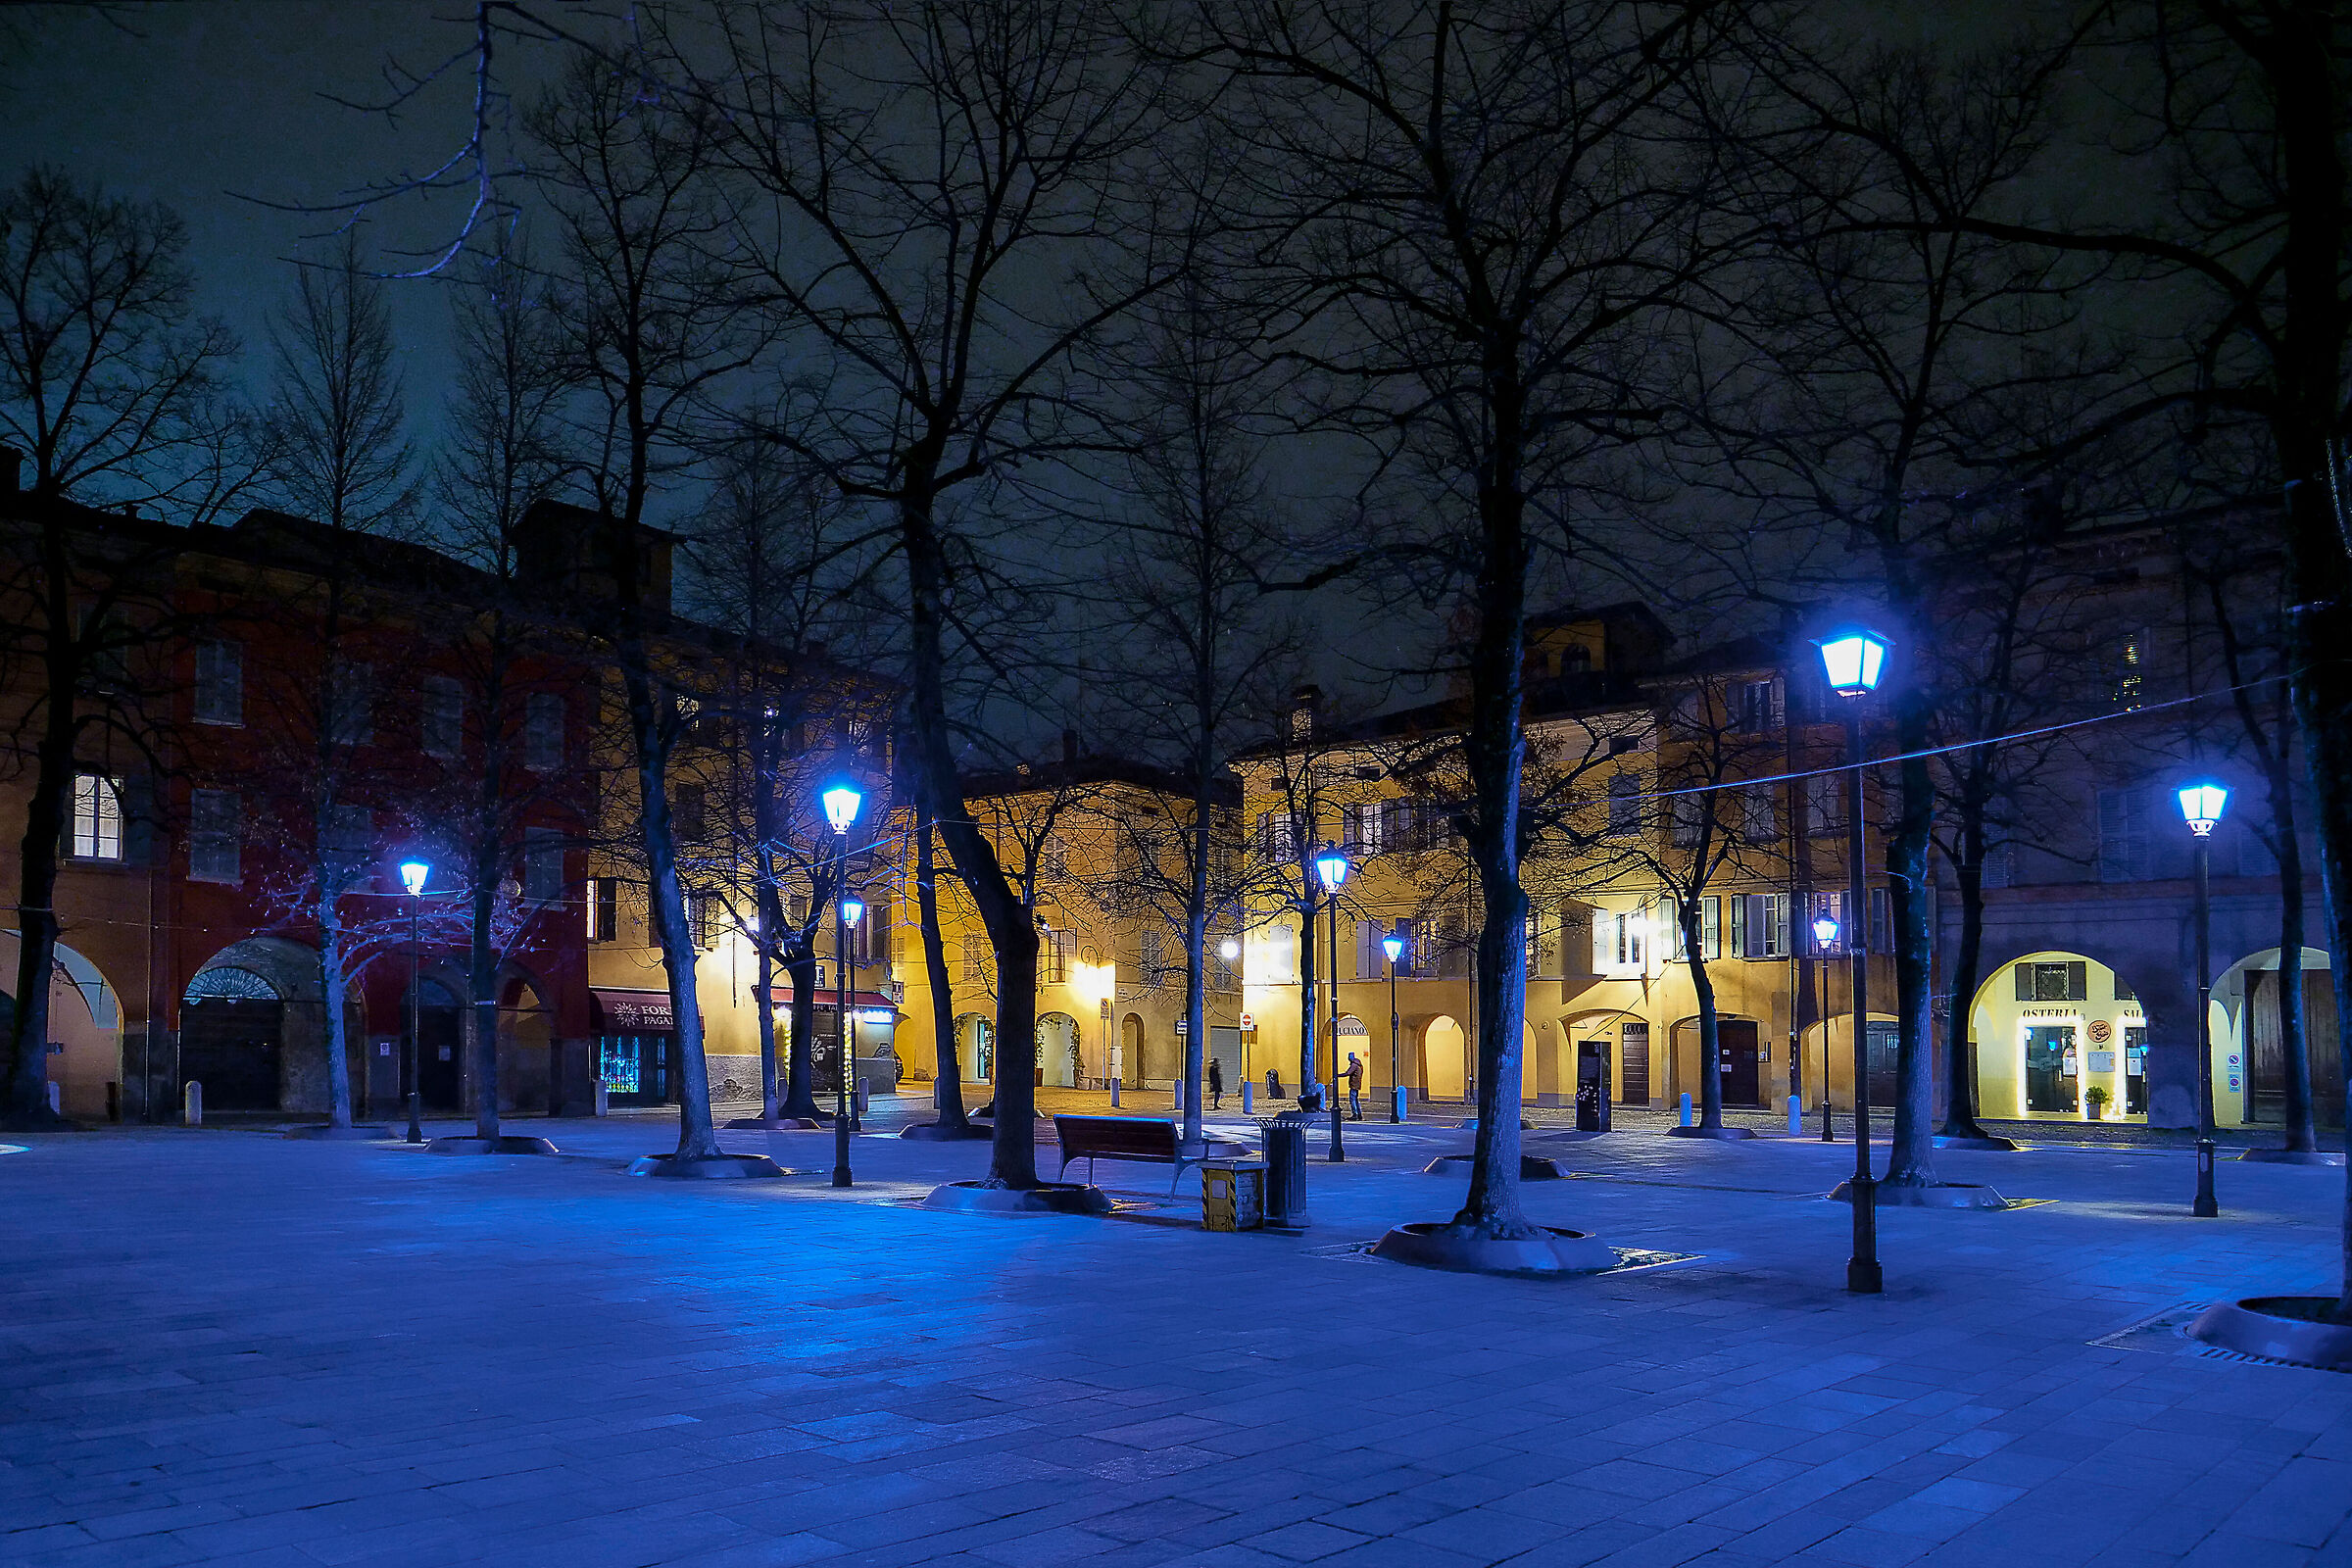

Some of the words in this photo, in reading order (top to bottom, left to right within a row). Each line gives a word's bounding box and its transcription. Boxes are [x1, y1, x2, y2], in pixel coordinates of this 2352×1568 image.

[640, 1005, 672, 1015] FOR
[2023, 1008, 2078, 1017] OSTERIA
[2124, 1009, 2142, 1018] SAL
